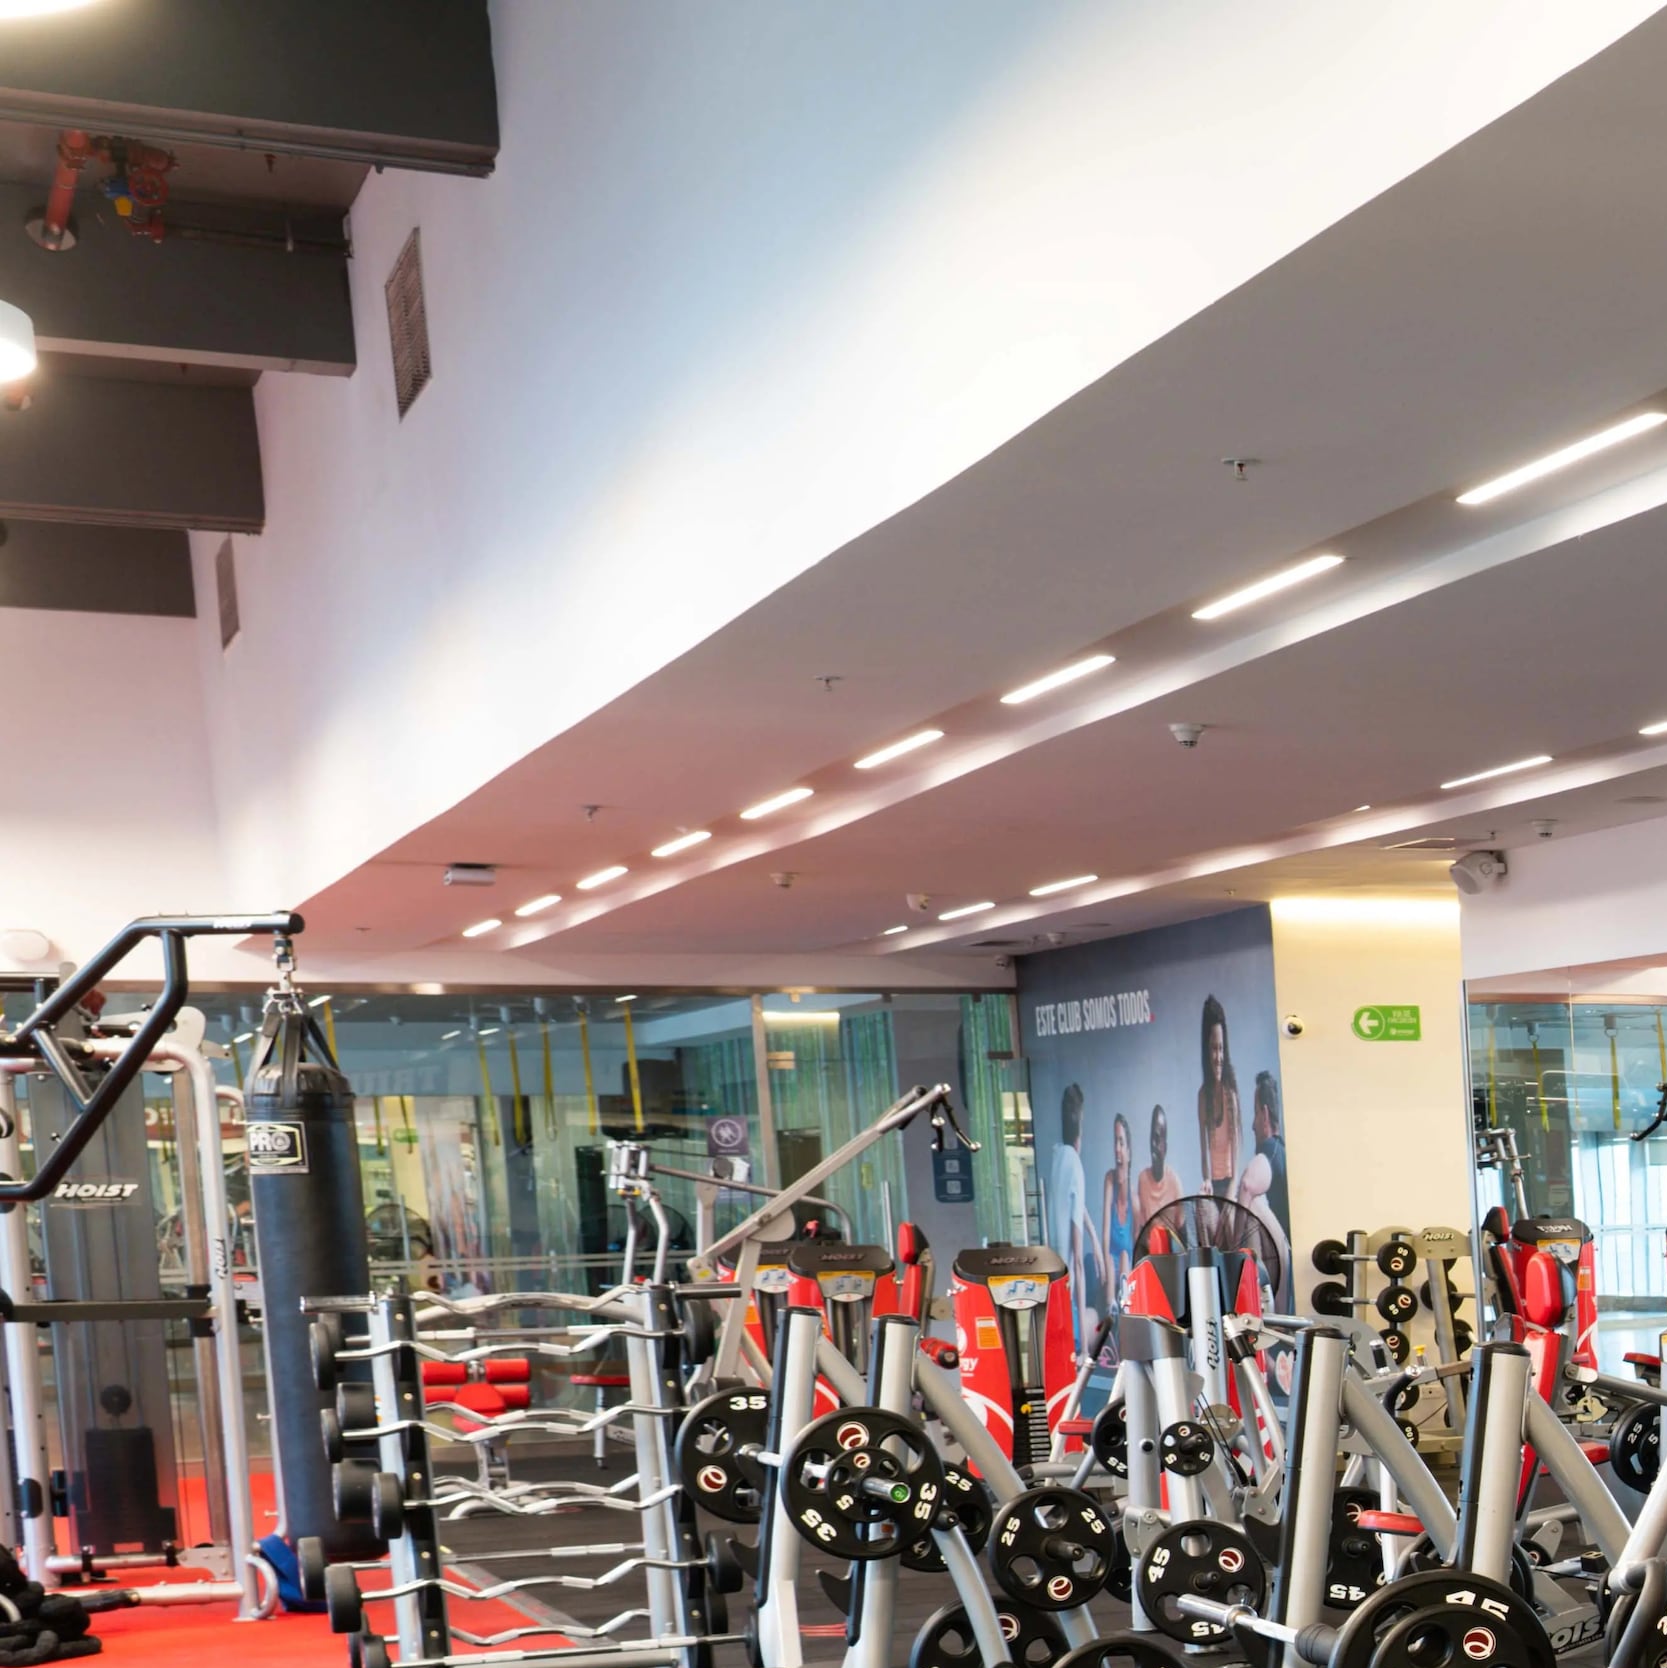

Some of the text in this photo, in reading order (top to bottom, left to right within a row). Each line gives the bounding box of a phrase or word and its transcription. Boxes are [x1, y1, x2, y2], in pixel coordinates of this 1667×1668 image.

[1036, 1005, 1056, 1037] ESTE
[1057, 1000, 1081, 1034] CLUB
[1082, 995, 1117, 1031] SOMOS
[54, 1183, 139, 1198] HOIST
[729, 1396, 768, 1411] 35
[1628, 1422, 1643, 1444] 25
[1164, 1453, 1177, 1465] 5
[1199, 1451, 1211, 1463] 5
[945, 1470, 973, 1492] 25
[836, 1494, 854, 1511] 5
[914, 1483, 938, 1520] 35
[799, 1509, 838, 1542] 35
[1000, 1517, 1021, 1547] 25
[1080, 1507, 1107, 1535] 25
[1148, 1547, 1170, 1583] 45
[1329, 1583, 1367, 1602] 45
